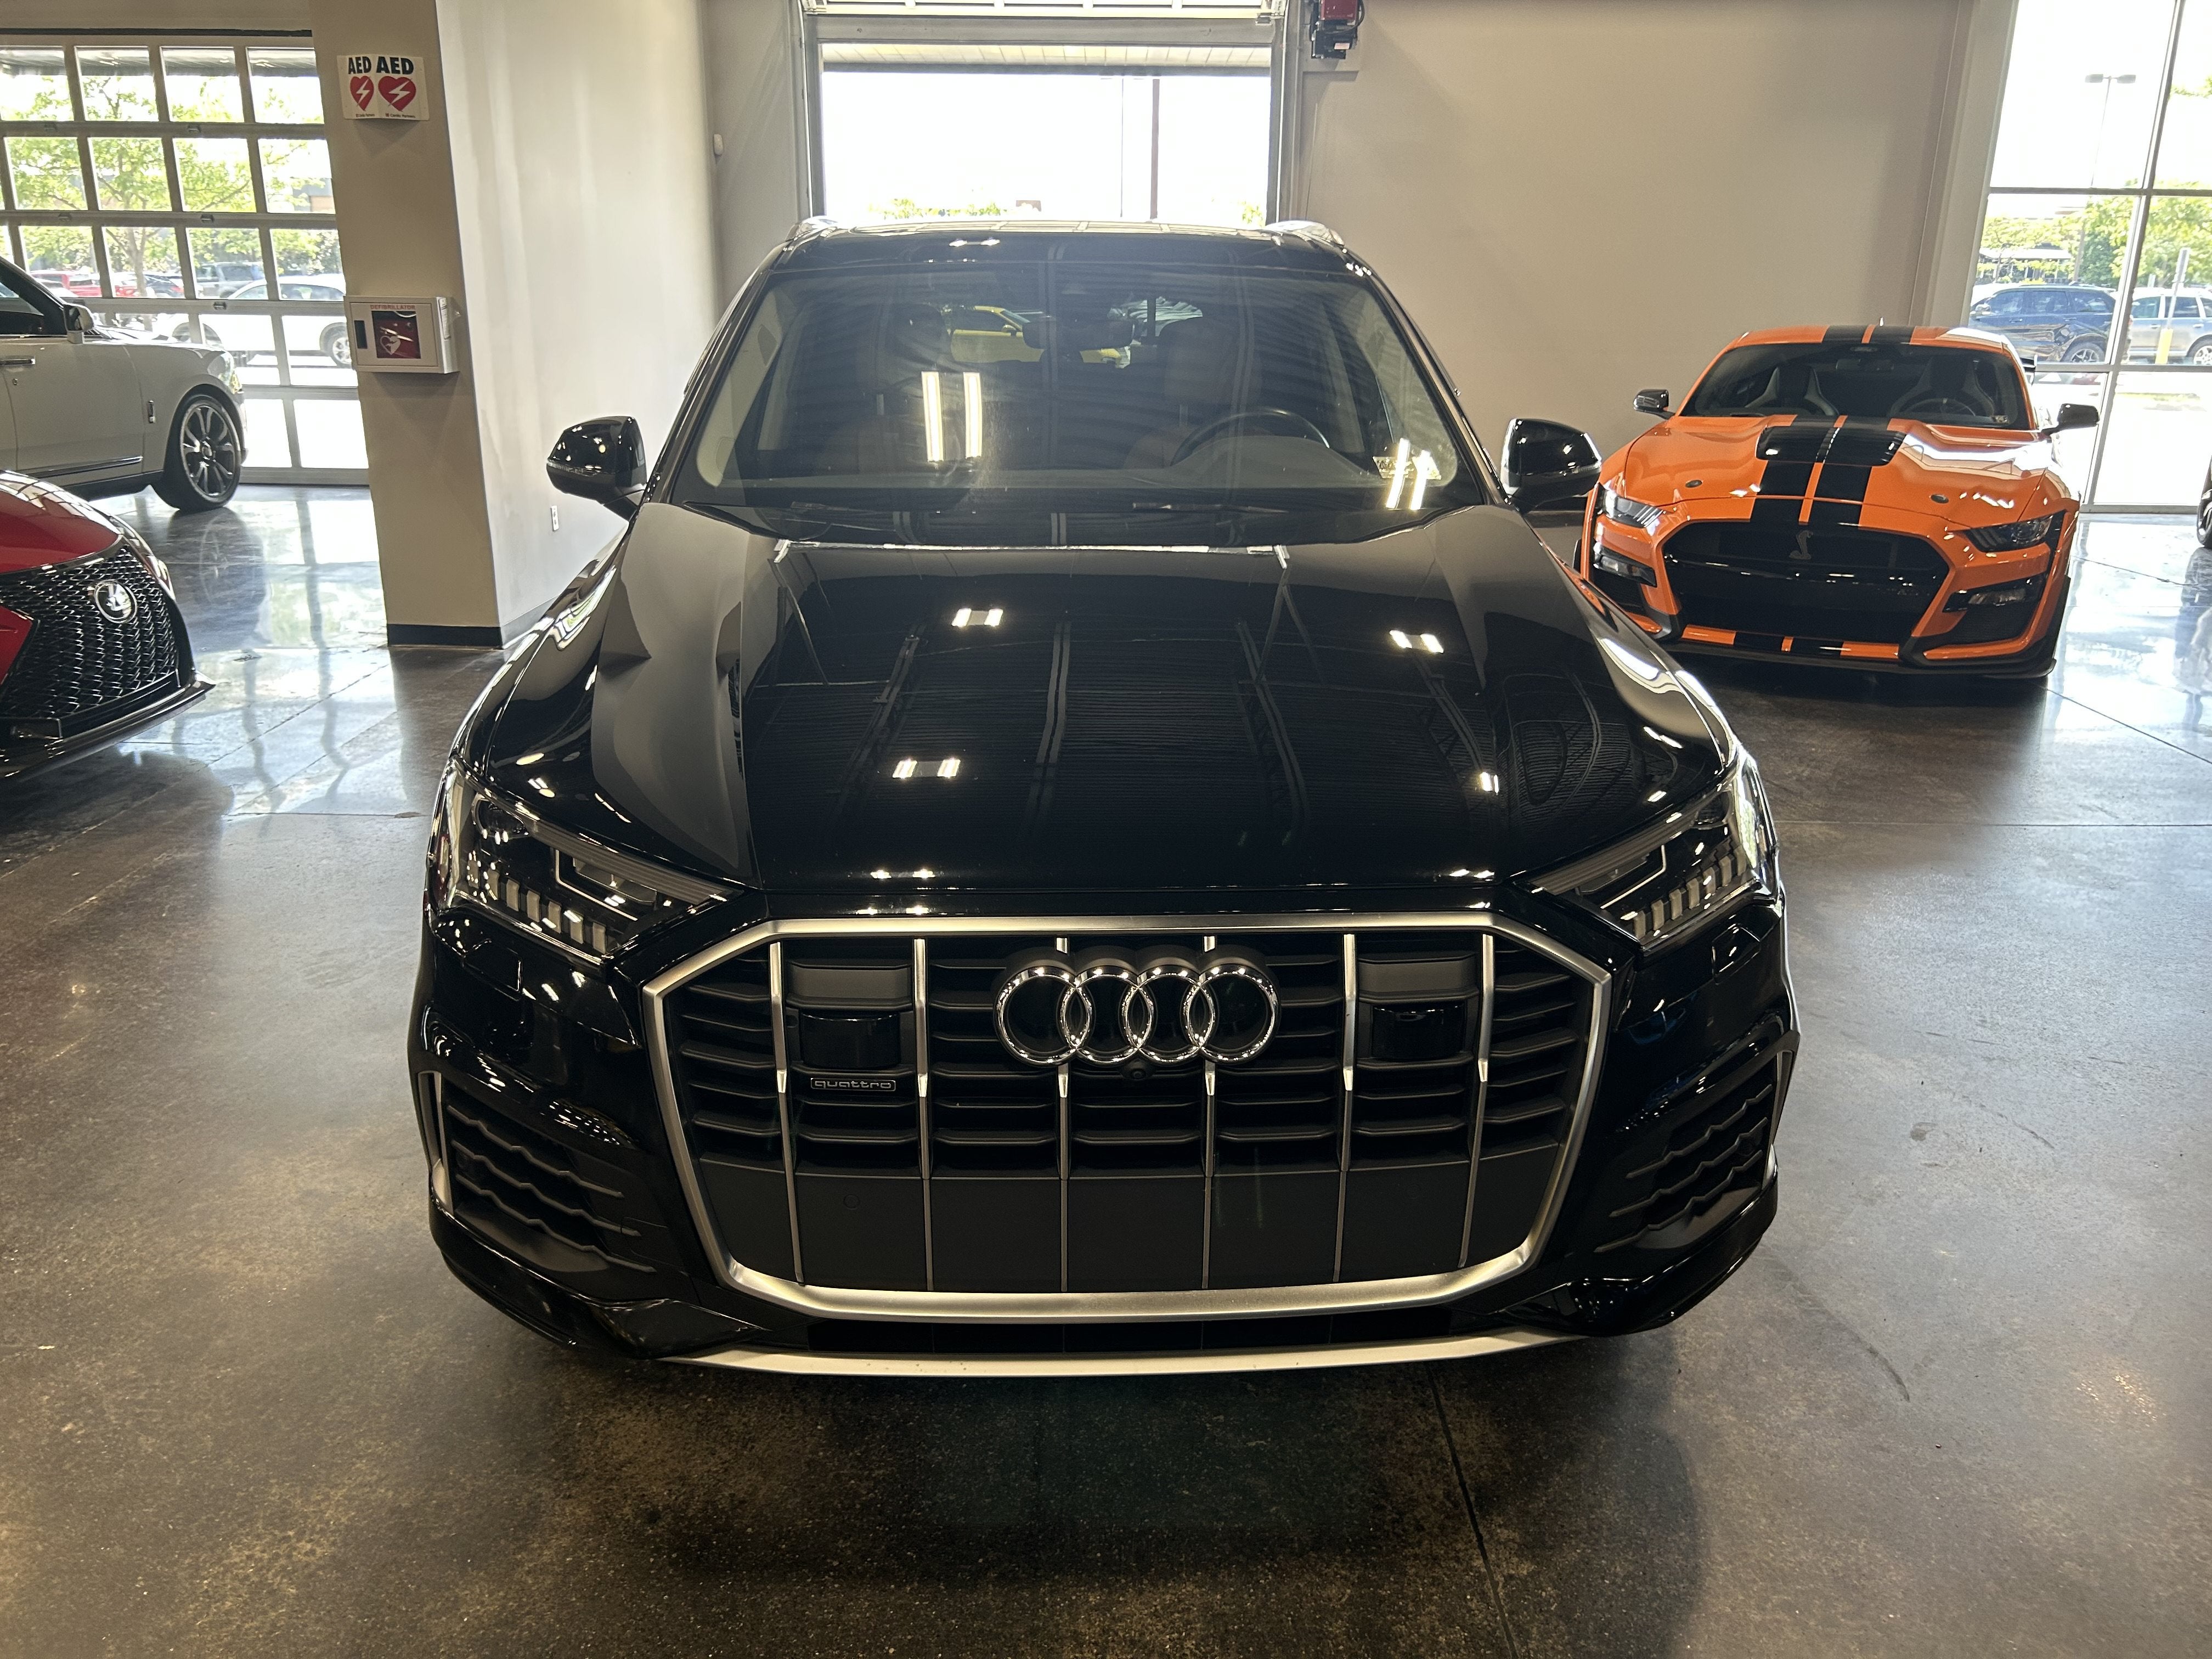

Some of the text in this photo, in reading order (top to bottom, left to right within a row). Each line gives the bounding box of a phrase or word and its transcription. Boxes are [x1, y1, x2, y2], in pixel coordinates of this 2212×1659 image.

[348, 56, 372, 75] AED
[376, 56, 414, 75] AED
[814, 1080, 891, 1089] quattro
